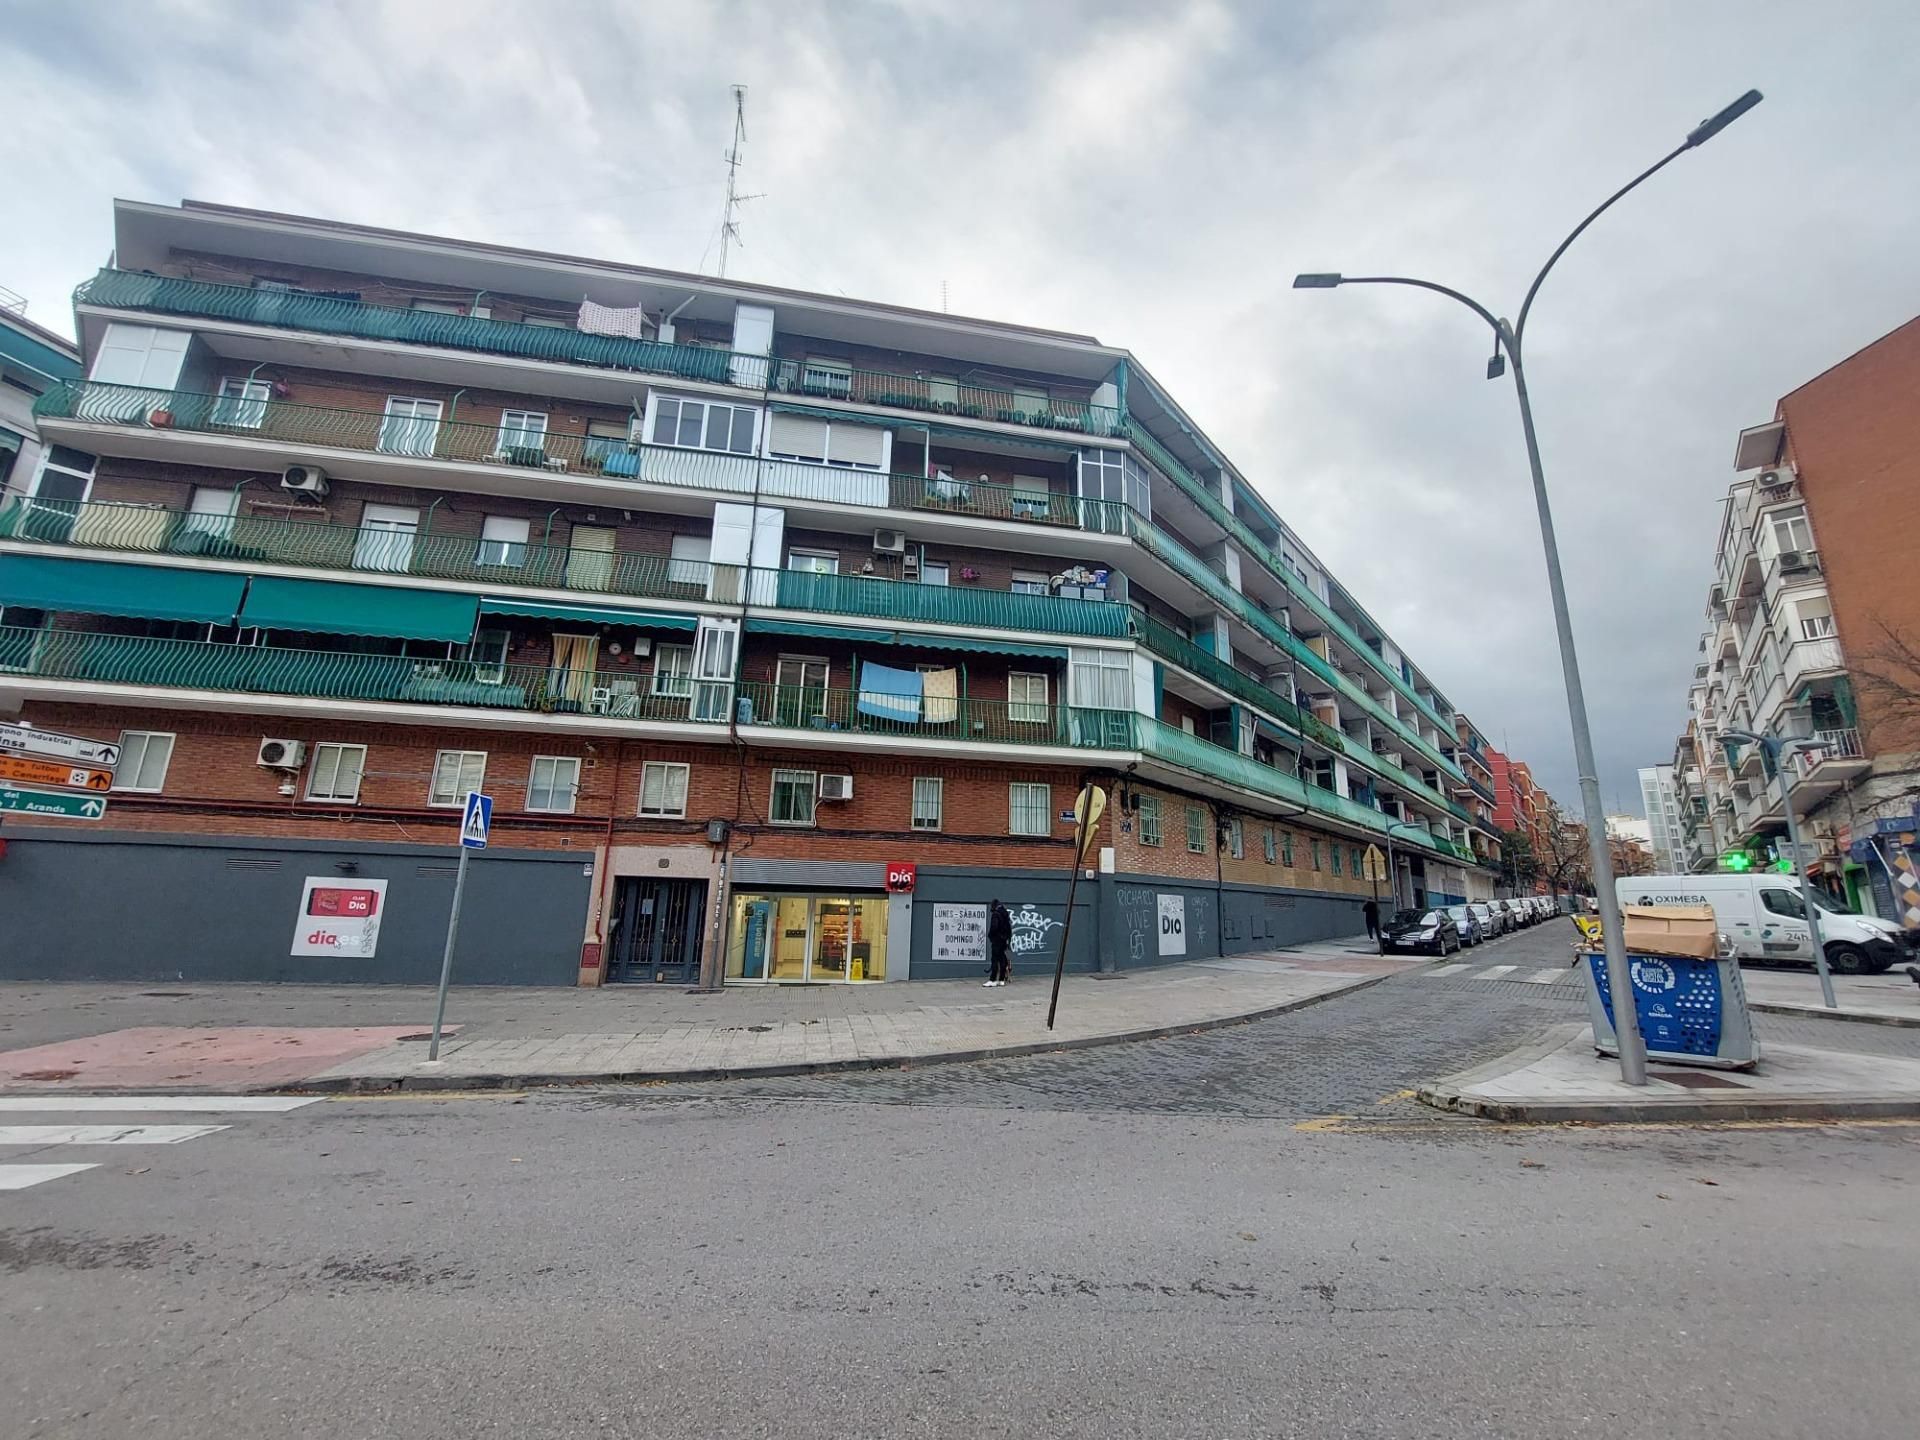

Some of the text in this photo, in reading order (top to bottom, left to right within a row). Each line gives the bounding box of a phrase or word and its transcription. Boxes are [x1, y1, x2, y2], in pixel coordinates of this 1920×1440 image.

[27, 732, 72, 746] industrial
[3, 791, 20, 799] del
[25, 802, 66, 814] Aranda
[1655, 895, 1707, 904] OXIMESA
[934, 909, 954, 919] LUNES
[939, 922, 950, 931] 9h
[754, 927, 763, 958] amazon
[945, 934, 974, 944] DOMINGO
